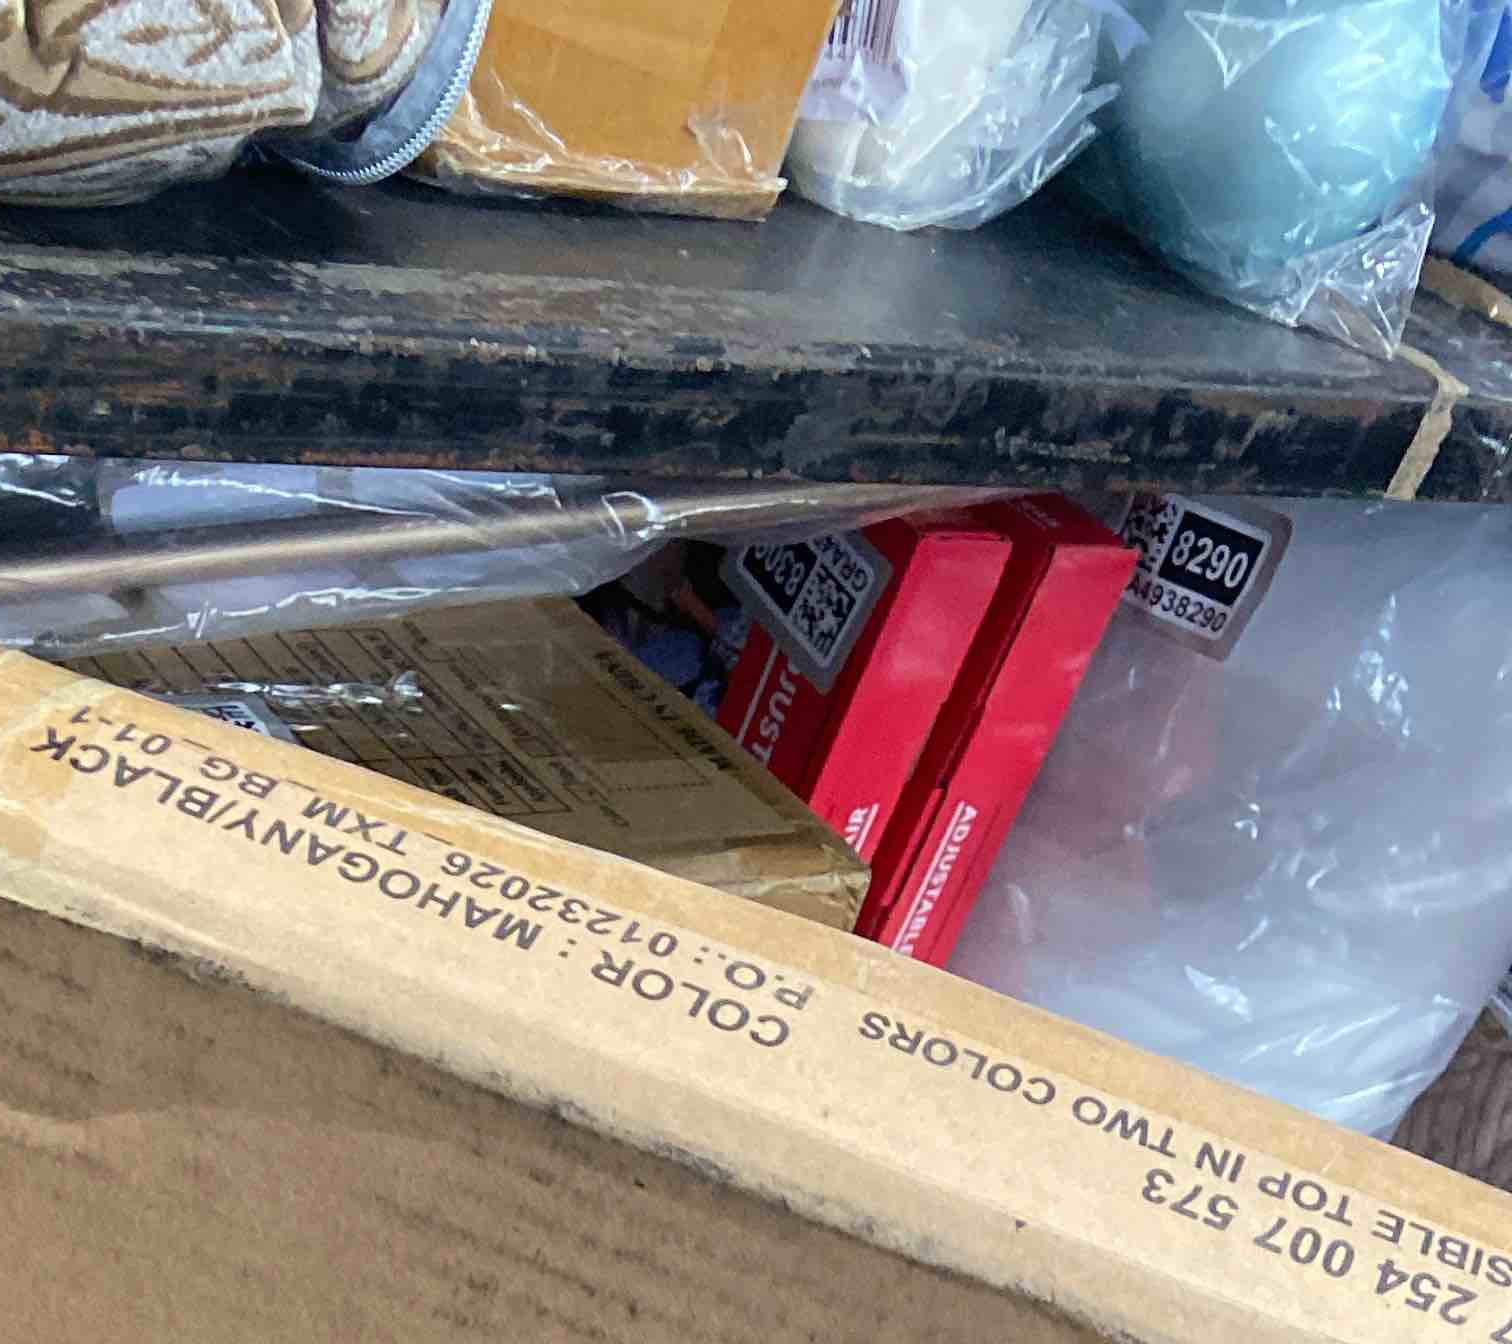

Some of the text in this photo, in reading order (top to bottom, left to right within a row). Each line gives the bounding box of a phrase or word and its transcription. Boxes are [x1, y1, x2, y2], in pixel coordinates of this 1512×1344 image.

[1171, 530, 1248, 589] 8290
[29, 726, 544, 951] MAHOGANY/BLACK
[590, 950, 790, 1048] COLOR
[858, 1011, 1056, 1106] COLORS
[1071, 1095, 1177, 1159] TWO
[1196, 1141, 1246, 1183] IN
[1141, 1168, 1239, 1230] 573
[1259, 1172, 1355, 1227] TOP
[1253, 1217, 1355, 1278] 007
[1374, 1259, 1479, 1327] 254
